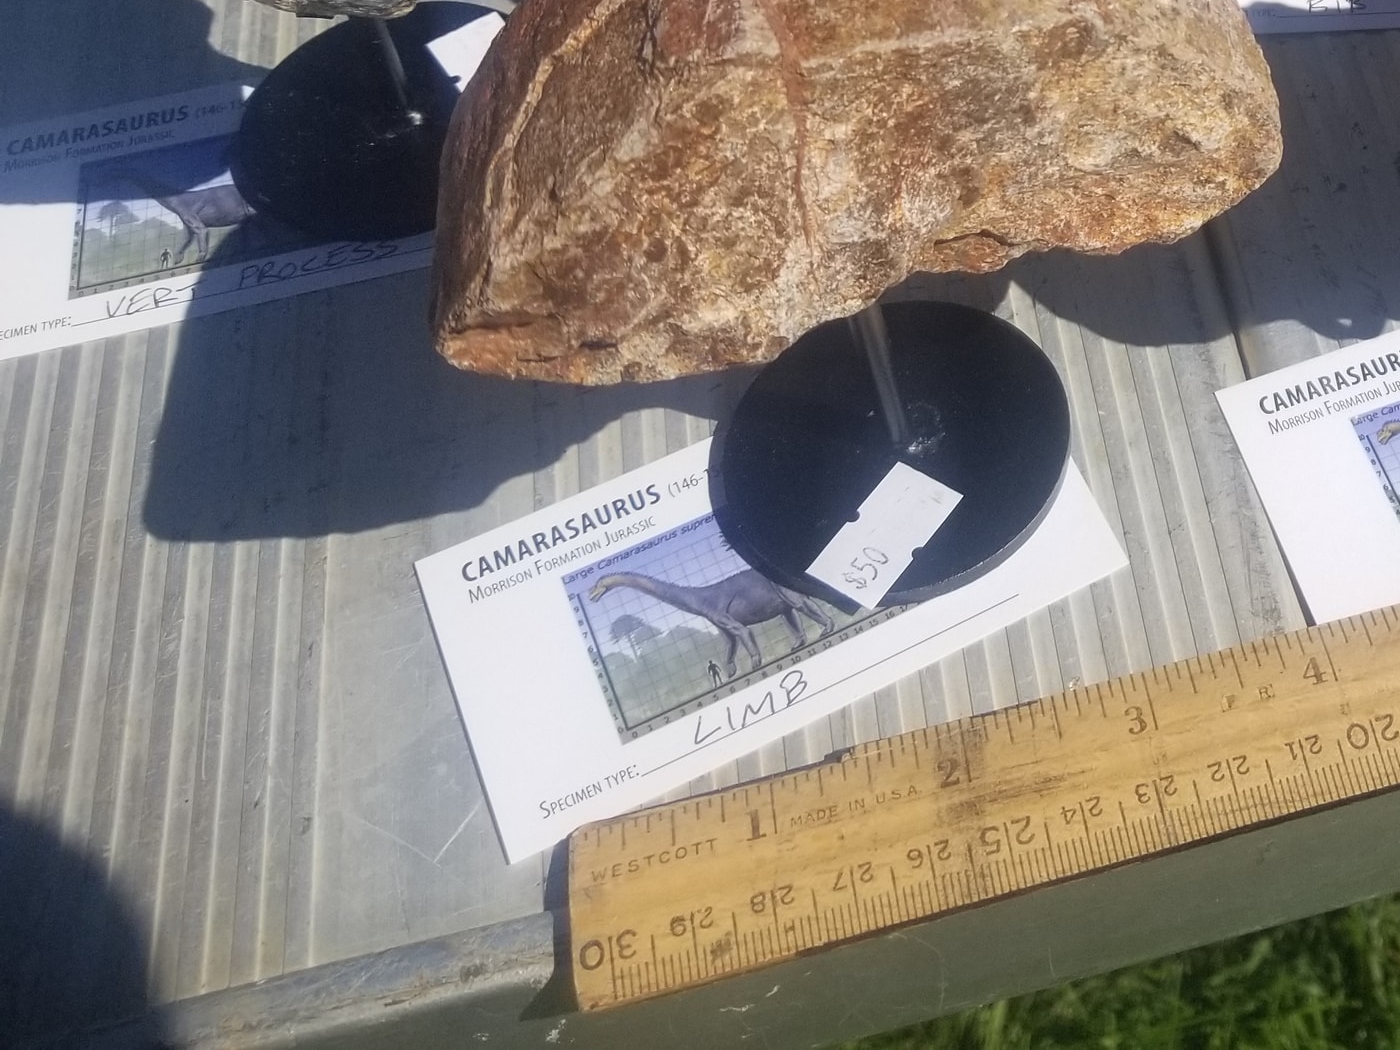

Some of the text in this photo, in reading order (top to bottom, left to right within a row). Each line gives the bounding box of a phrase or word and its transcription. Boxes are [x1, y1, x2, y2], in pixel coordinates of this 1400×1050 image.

[7, 105, 190, 156] CAMARASAURUS
[106, 240, 399, 319] VERT PROCESS
[0, 316, 72, 341] ECIMEN TYPE:
[1267, 407, 1324, 435] MORRISON
[1324, 387, 1383, 416] FORMATION
[1351, 410, 1380, 426] Large
[461, 483, 662, 582] CAMARASAURUS
[468, 515, 657, 604] MORRISON FORMATION JURASSIC
[563, 565, 596, 586] Large
[597, 529, 679, 571] Camarasaurus
[842, 546, 889, 590] $50
[694, 670, 808, 745] LIMB
[745, 808, 767, 841] 1
[936, 757, 961, 789] 2
[1124, 705, 1148, 735] 3
[1302, 656, 1329, 686] 4
[1283, 734, 1323, 762] 21
[1347, 713, 1400, 750] 20
[1134, 774, 1178, 804] 23
[1206, 754, 1250, 783] 22
[540, 762, 641, 819] SPECIMEN TYPE:
[789, 783, 922, 828] MADE IN U.S.A.
[1060, 796, 1104, 826] 24
[906, 838, 952, 869] 26
[978, 815, 1036, 856] 25
[590, 837, 718, 883] WESTCOTT
[832, 861, 875, 893] 27
[750, 883, 796, 914] 28
[670, 906, 716, 937] 29
[579, 928, 639, 971] 30
